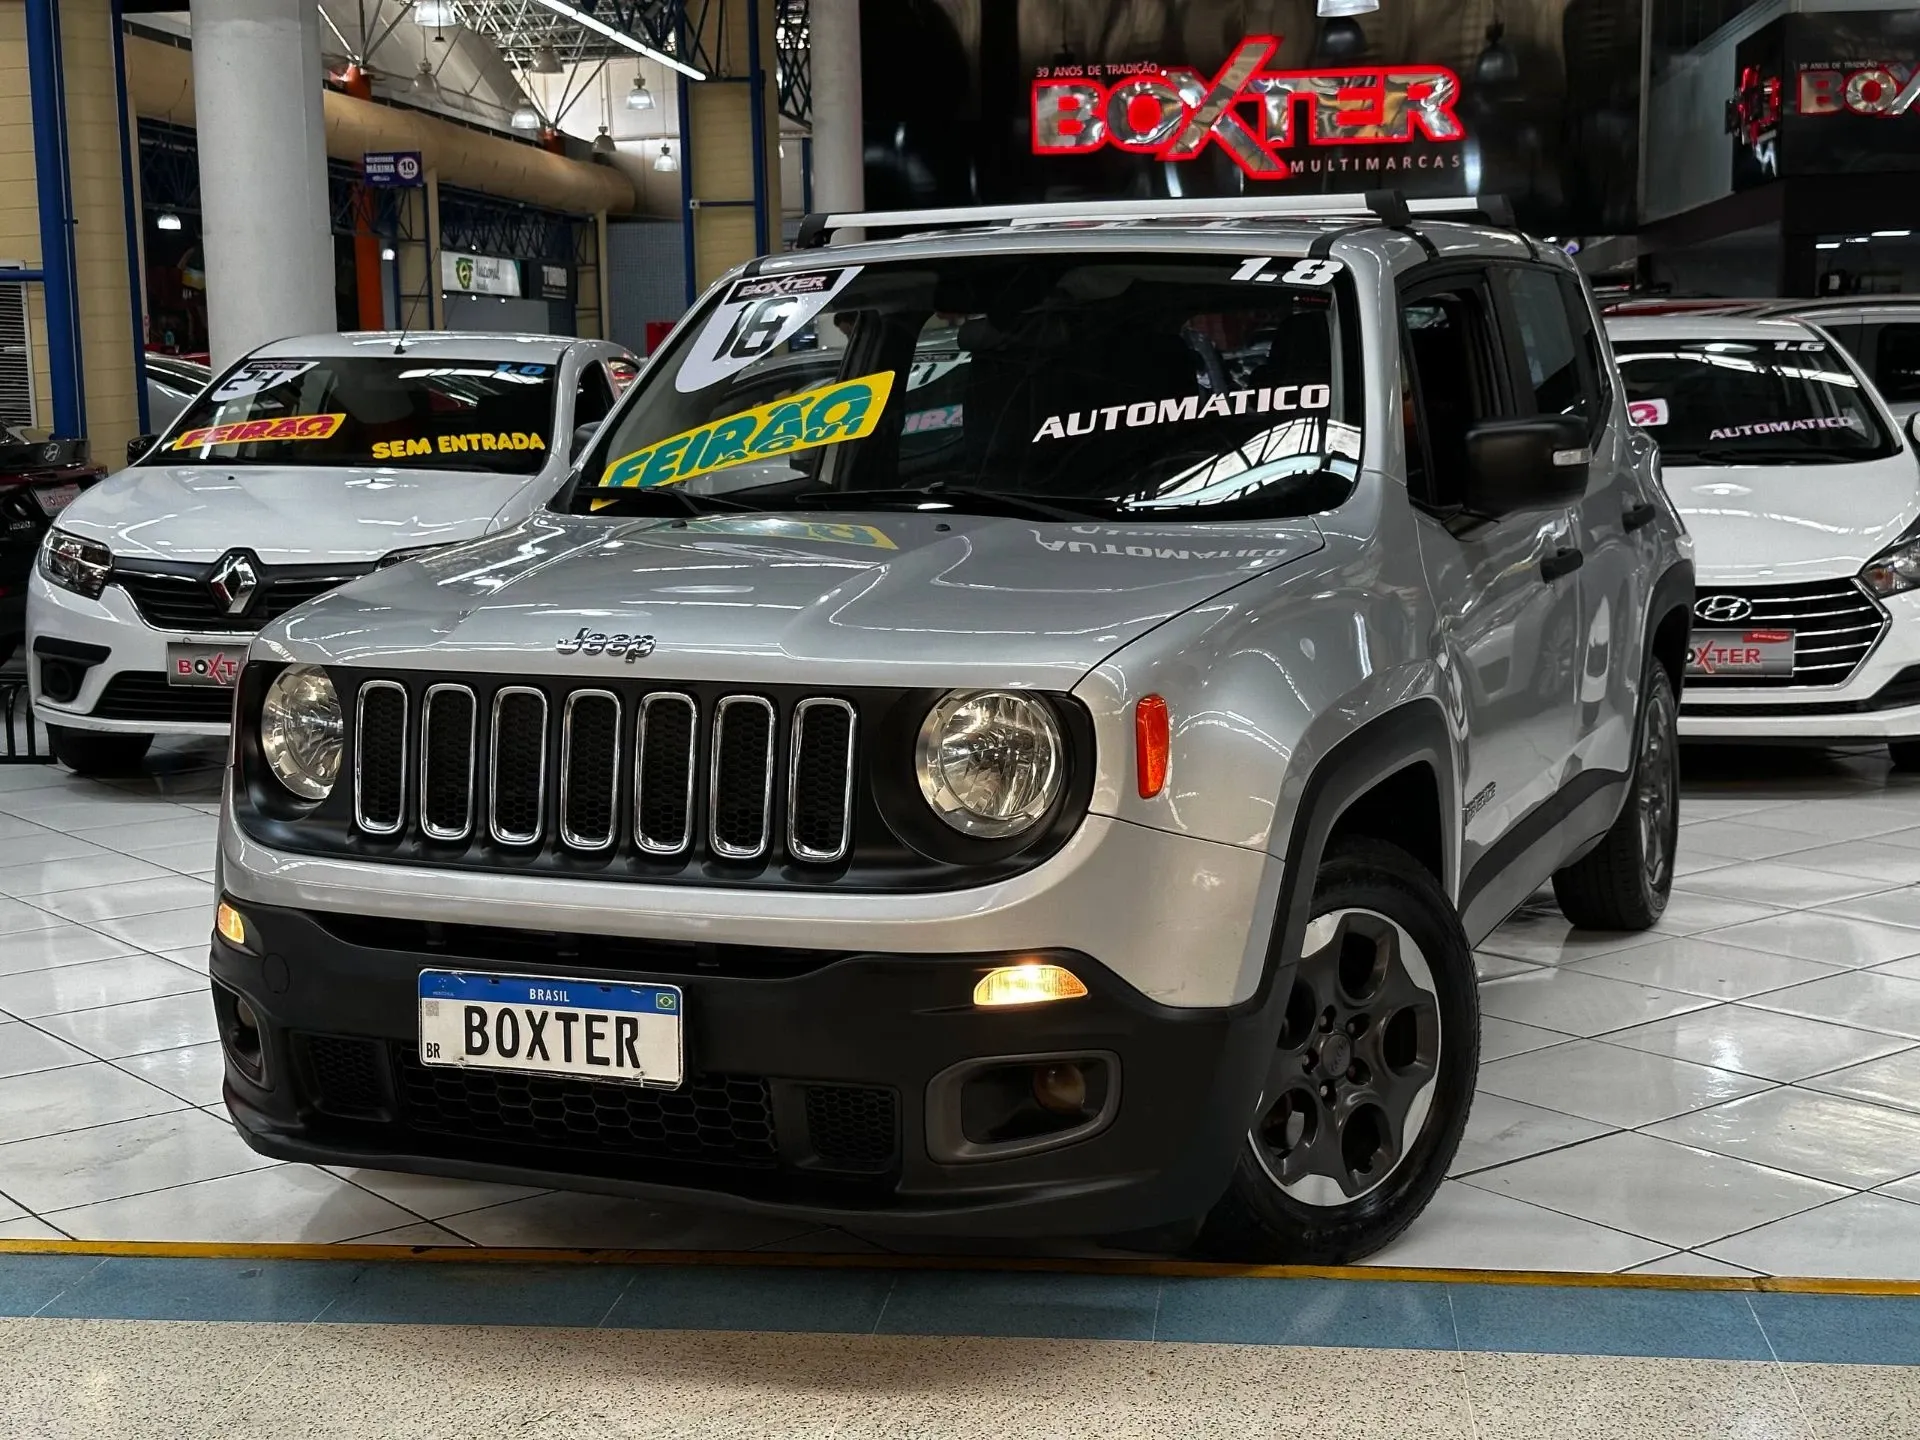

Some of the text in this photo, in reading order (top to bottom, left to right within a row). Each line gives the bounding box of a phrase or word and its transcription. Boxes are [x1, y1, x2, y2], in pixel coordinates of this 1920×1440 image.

[1036, 61, 1158, 78] 39 ANOS DE TRADIÇÃO
[1032, 35, 1467, 181] BOXTER
[401, 161, 414, 171] 10
[1291, 153, 1461, 174] MULTIMARCAS
[1230, 257, 1343, 286] 1.8
[738, 275, 828, 297] BOXTER
[220, 370, 284, 391] 24
[1709, 416, 1854, 440] AUTOMATICO
[371, 432, 546, 459] SEM ENTRADA
[556, 627, 657, 664] Jeep
[1685, 640, 1761, 674] OXTER
[177, 652, 240, 685] BOXT
[529, 988, 570, 1002] BRASIL
[464, 1004, 641, 1069] BOXTER
[426, 1042, 441, 1059] BR
